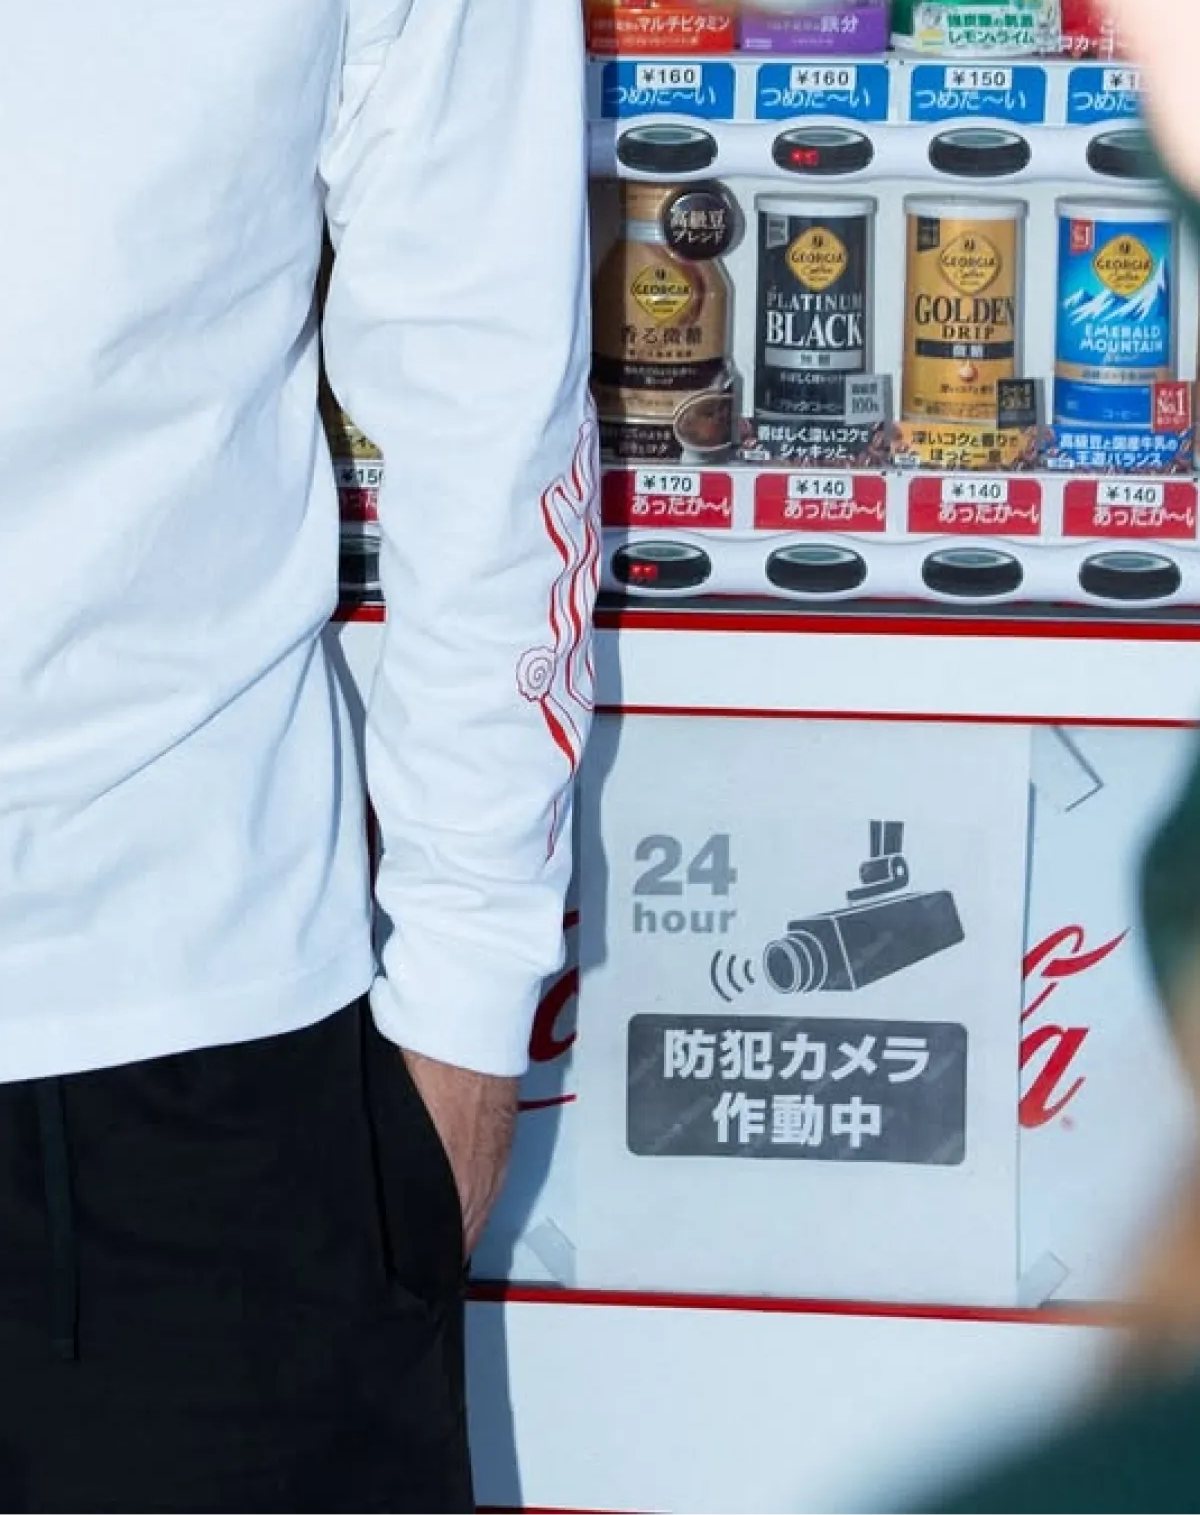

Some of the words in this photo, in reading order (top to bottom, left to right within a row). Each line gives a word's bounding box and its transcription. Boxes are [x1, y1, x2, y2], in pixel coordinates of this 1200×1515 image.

[643, 67, 695, 84] ¥160
[798, 69, 849, 86] ¥160
[953, 70, 1006, 87] ¥150
[671, 229, 724, 244] ブレンド
[790, 252, 845, 264] GEORGIA
[941, 256, 996, 268] GEORGIA
[766, 292, 863, 311] PLATINUM
[766, 310, 864, 347] BLACK
[941, 325, 995, 340] DRIP
[1084, 323, 1161, 338] EMERALD
[1080, 338, 1163, 353] MOUNTAIN
[643, 476, 692, 493] ¥170
[797, 479, 845, 497] ¥140
[952, 482, 1001, 499] ¥140
[1106, 485, 1156, 502] ¥140
[633, 833, 738, 896] 24
[632, 901, 737, 934] hour
[663, 1028, 930, 1083] 防犯カメラ
[711, 1091, 882, 1148] 作動中
